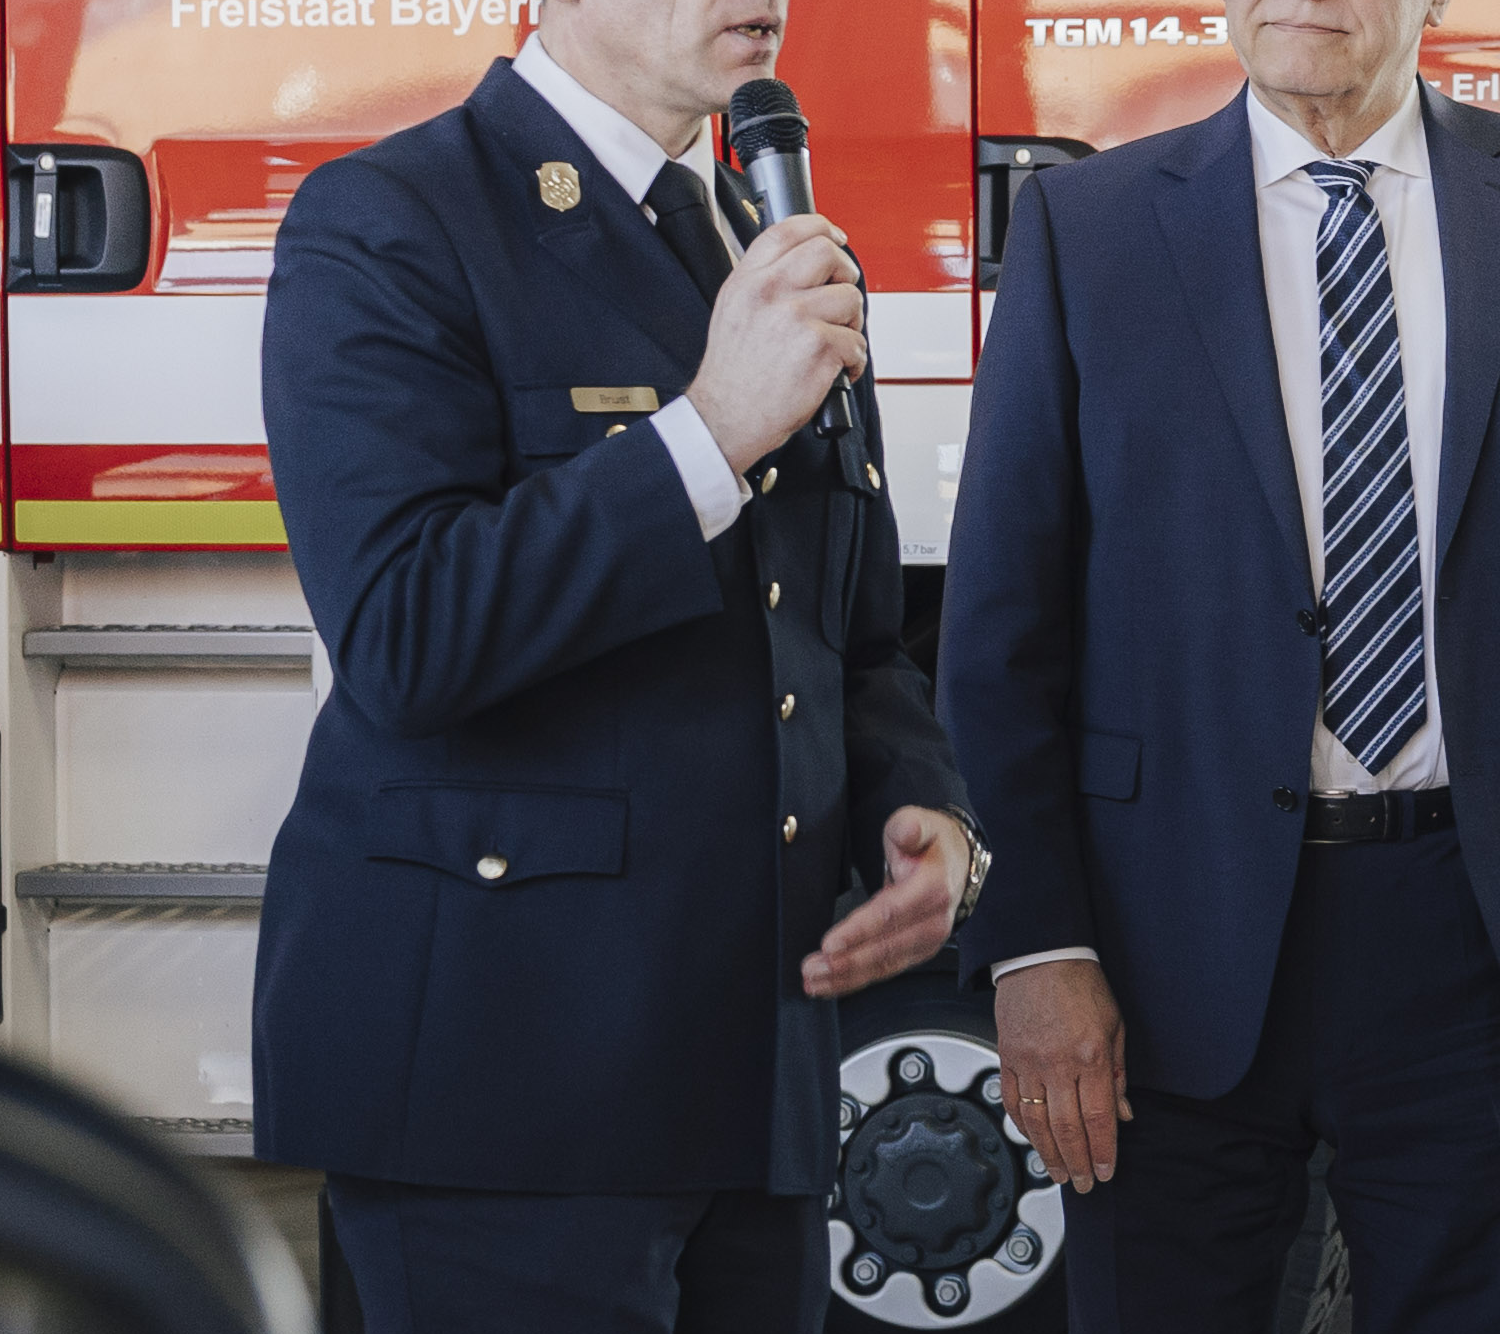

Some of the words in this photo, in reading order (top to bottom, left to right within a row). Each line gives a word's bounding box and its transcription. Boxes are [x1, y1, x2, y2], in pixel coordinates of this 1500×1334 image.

[1025, 17, 1123, 47] TGM
[1129, 16, 1229, 46] 14.3
[920, 544, 938, 555] bar
